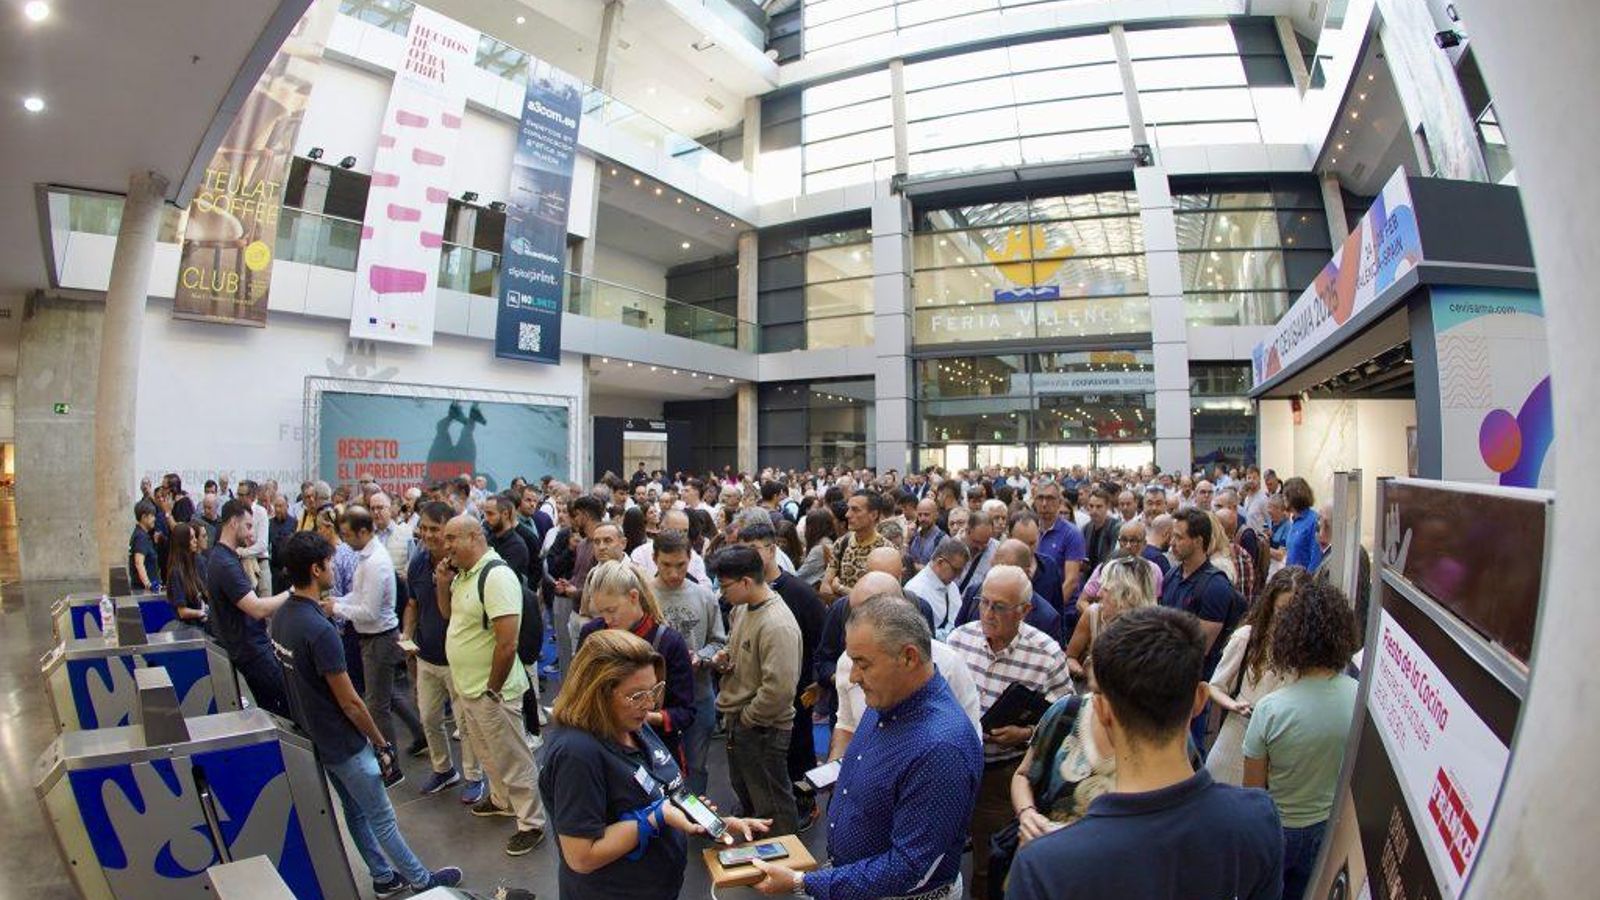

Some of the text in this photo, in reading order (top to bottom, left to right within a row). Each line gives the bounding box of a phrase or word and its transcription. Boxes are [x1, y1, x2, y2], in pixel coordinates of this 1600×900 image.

[408, 47, 446, 72] OTRA
[204, 167, 281, 199] TEULAT
[196, 192, 279, 224] COFFEE
[182, 266, 240, 293] CLUB
[930, 306, 1131, 333] FERIA VALENC
[1448, 303, 1518, 316] cevisama.com
[337, 438, 399, 459] RESPETO
[338, 462, 351, 480] EL
[354, 462, 426, 481] INGREDIENTE
[1418, 672, 1450, 733] Cocina
